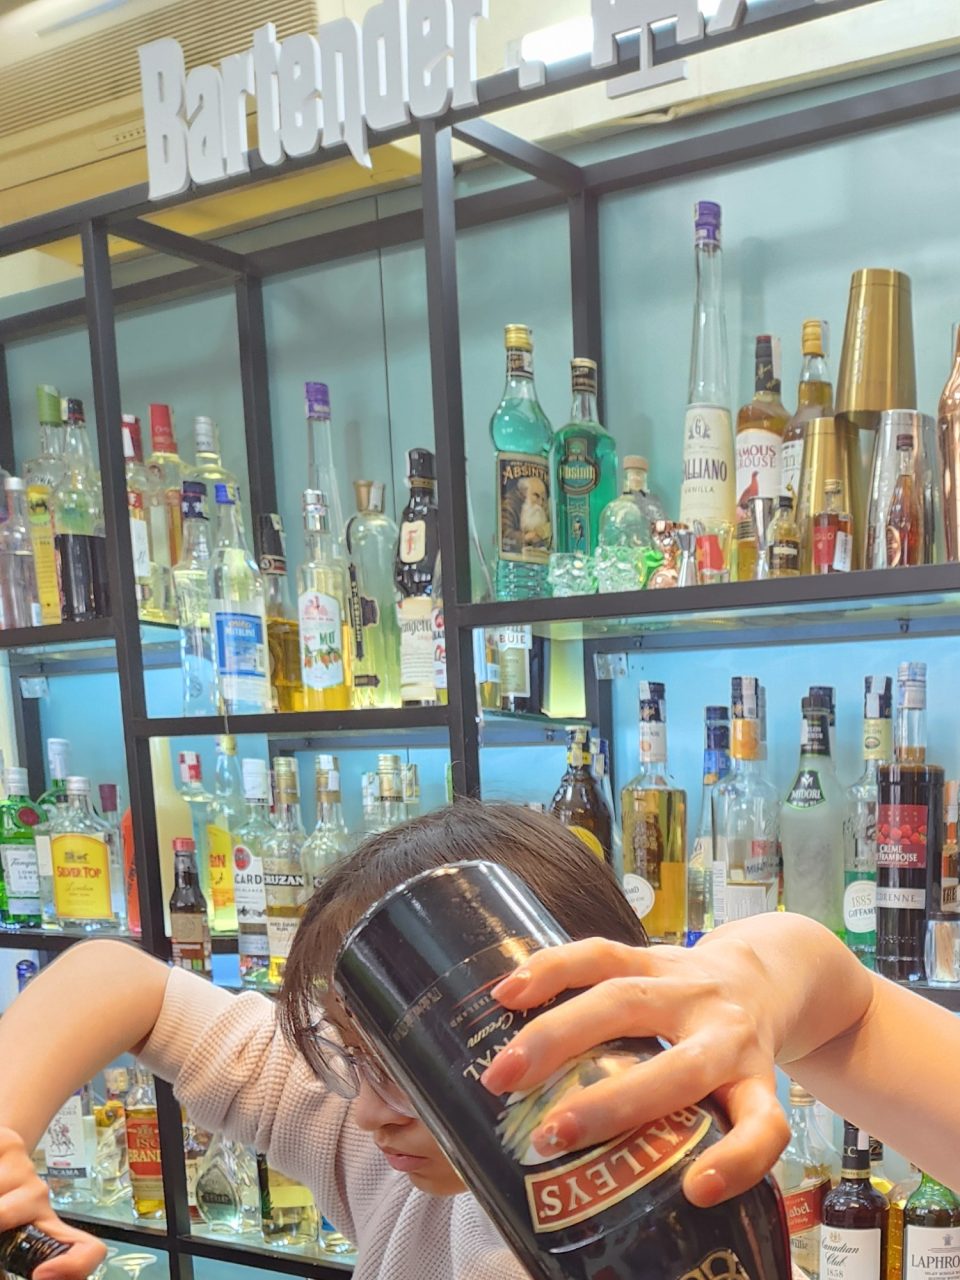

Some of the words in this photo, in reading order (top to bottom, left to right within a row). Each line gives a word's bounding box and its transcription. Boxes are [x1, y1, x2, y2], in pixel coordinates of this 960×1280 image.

[138, 0, 488, 199] Bartender
[790, 788, 821, 800] MIDORI
[56, 866, 81, 878] SILVER
[83, 866, 102, 879] TOP
[851, 894, 873, 908] 1885
[467, 1011, 514, 1049] Cream
[540, 1105, 700, 1218] BAILEYS
[821, 1237, 860, 1254] Canadian
[825, 1251, 849, 1267] Club
